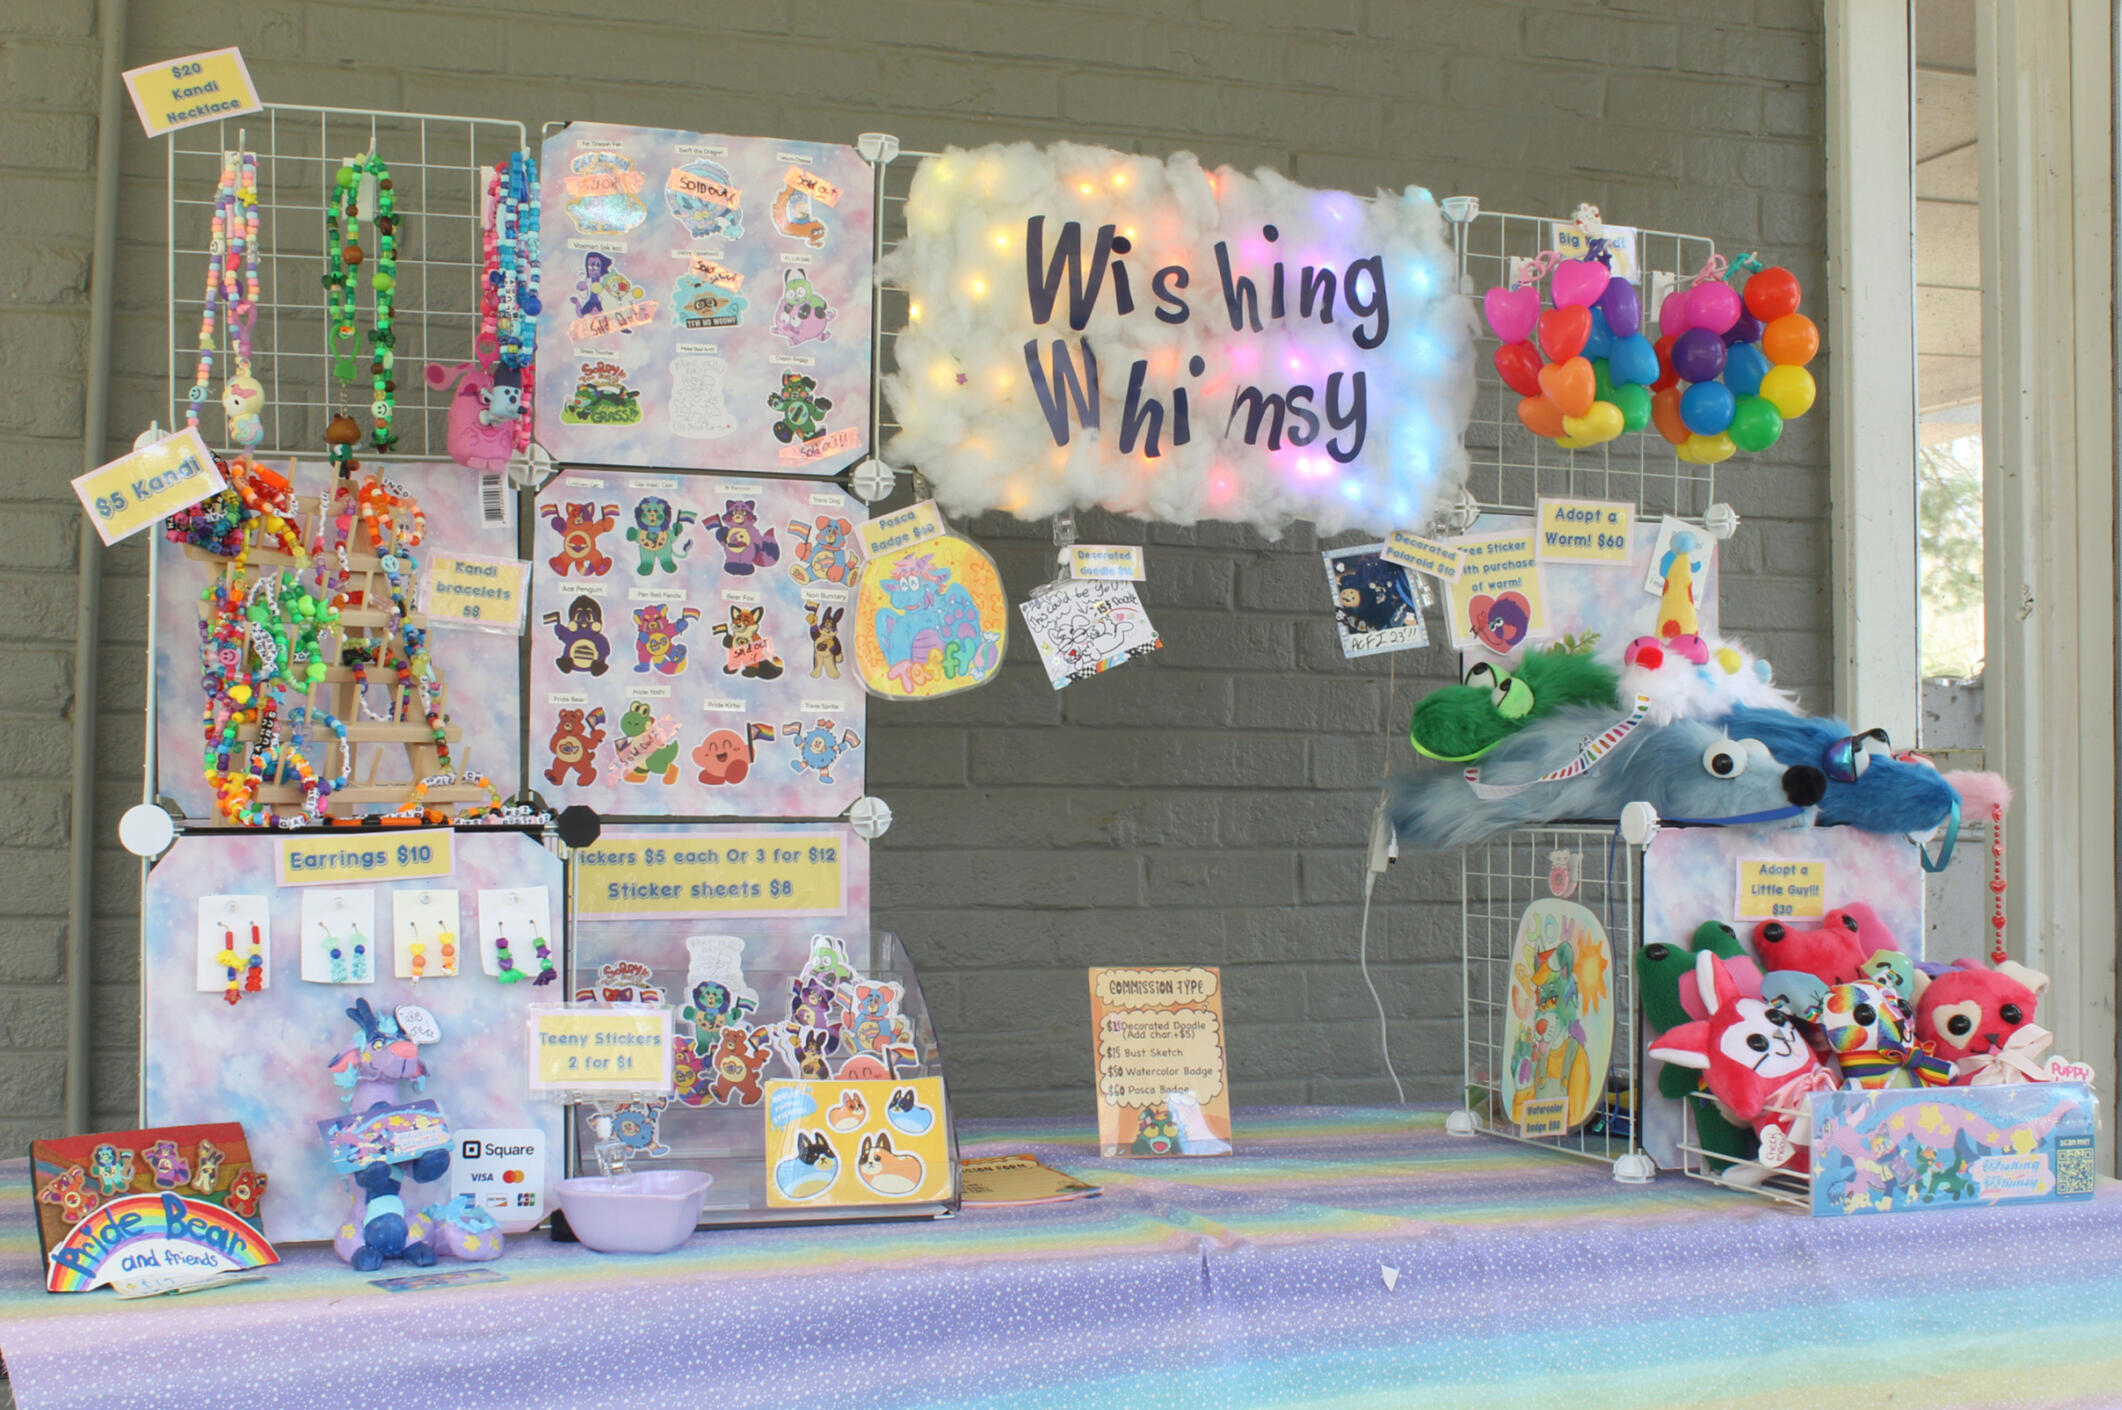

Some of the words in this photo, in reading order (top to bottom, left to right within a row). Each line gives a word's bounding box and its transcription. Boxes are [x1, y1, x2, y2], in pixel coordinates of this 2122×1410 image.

[171, 63, 203, 79] $20
[171, 80, 220, 100] Kandi
[165, 99, 241, 124] Necklace
[1559, 232, 1580, 248] Big
[1026, 214, 1391, 349] Wishing
[1023, 337, 1368, 463] Whimsy
[95, 491, 128, 520] $5
[130, 455, 203, 501] Kandi
[878, 511, 916, 531] Posca
[1554, 507, 1602, 524] Adopt
[1607, 511, 1618, 523] a
[871, 531, 910, 552] Badge
[1394, 532, 1457, 561] Decorated
[1487, 540, 1527, 552] Sticker
[1545, 532, 1592, 546] Worm!
[1597, 534, 1625, 549] $60
[1077, 550, 1132, 560] Decorated
[1387, 546, 1435, 570] Polaroid
[455, 561, 499, 577] Kandi
[1463, 563, 1480, 576] ith
[1484, 558, 1537, 576] purchase
[436, 580, 512, 600] bracelets
[576, 585, 603, 594] Penguin
[1472, 580, 1484, 592] of
[1488, 577, 1523, 590] worm!
[462, 604, 481, 618] 5$
[1029, 610, 1049, 628] This
[1075, 587, 1090, 598] be
[553, 695, 570, 703] Pride
[290, 850, 388, 870] Earrings
[397, 844, 433, 867] $10
[644, 848, 666, 865] $5
[673, 848, 719, 864] each
[725, 847, 749, 863] Or
[755, 847, 766, 863] 3
[773, 847, 801, 863] for
[807, 846, 837, 864] $12
[1759, 864, 1797, 877] Adopt
[1800, 866, 1809, 875] a
[607, 880, 683, 899] Sticker
[690, 880, 761, 898] sheets
[769, 878, 794, 897] $8
[1751, 884, 1783, 895] Little
[1109, 979, 1174, 996] COMMISSION
[1177, 979, 1204, 996] TYPE
[1120, 1021, 1171, 1031] Decorated
[1173, 1021, 1206, 1031] Doodle
[539, 1032, 588, 1048] Teeny
[594, 1031, 661, 1046] Stickers
[1122, 1030, 1146, 1040] (Add
[1124, 1049, 1146, 1058] Bust
[1150, 1049, 1184, 1058] Sketch
[568, 1056, 578, 1069] 2
[585, 1056, 610, 1069] for
[616, 1055, 633, 1070] $1
[1124, 1067, 1180, 1077] Watercolor
[1183, 1066, 1213, 1078] Badge
[1128, 1085, 1156, 1095] Posca
[1159, 1085, 1190, 1096] Badge
[1527, 1104, 1563, 1116] Watercolor
[1526, 1122, 1547, 1134] Badge
[484, 1143, 535, 1158] Square
[1983, 1158, 2041, 1172] Wishing
[470, 1173, 494, 1182] VISA
[1983, 1177, 2040, 1190] Whimsy
[50, 1207, 146, 1279] Pride
[161, 1193, 248, 1256] Bear
[121, 1248, 161, 1272] and
[164, 1249, 218, 1269] friends
